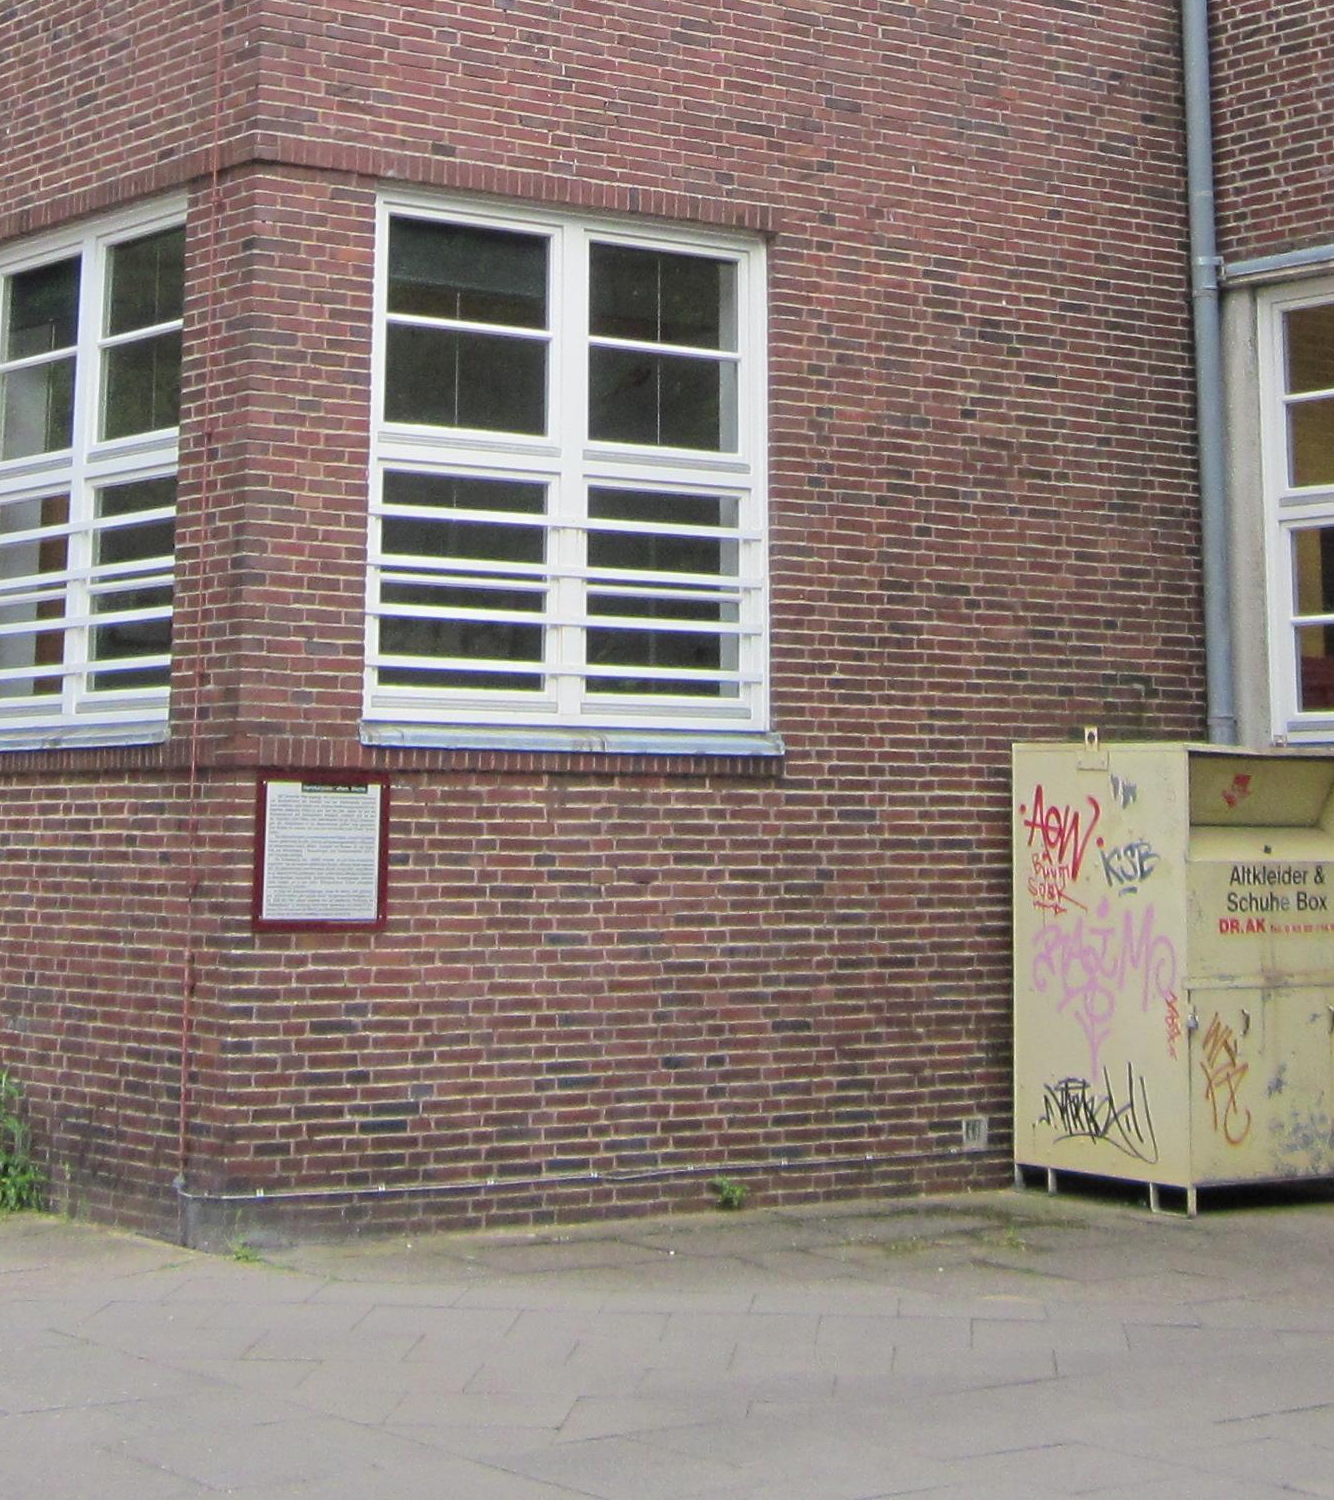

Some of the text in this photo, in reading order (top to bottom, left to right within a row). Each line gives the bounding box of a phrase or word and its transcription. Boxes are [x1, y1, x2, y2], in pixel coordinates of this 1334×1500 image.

[1229, 865, 1325, 886] Altkleider &
[1227, 891, 1328, 913] Schuhe Box
[1218, 918, 1266, 934] DR.AK
